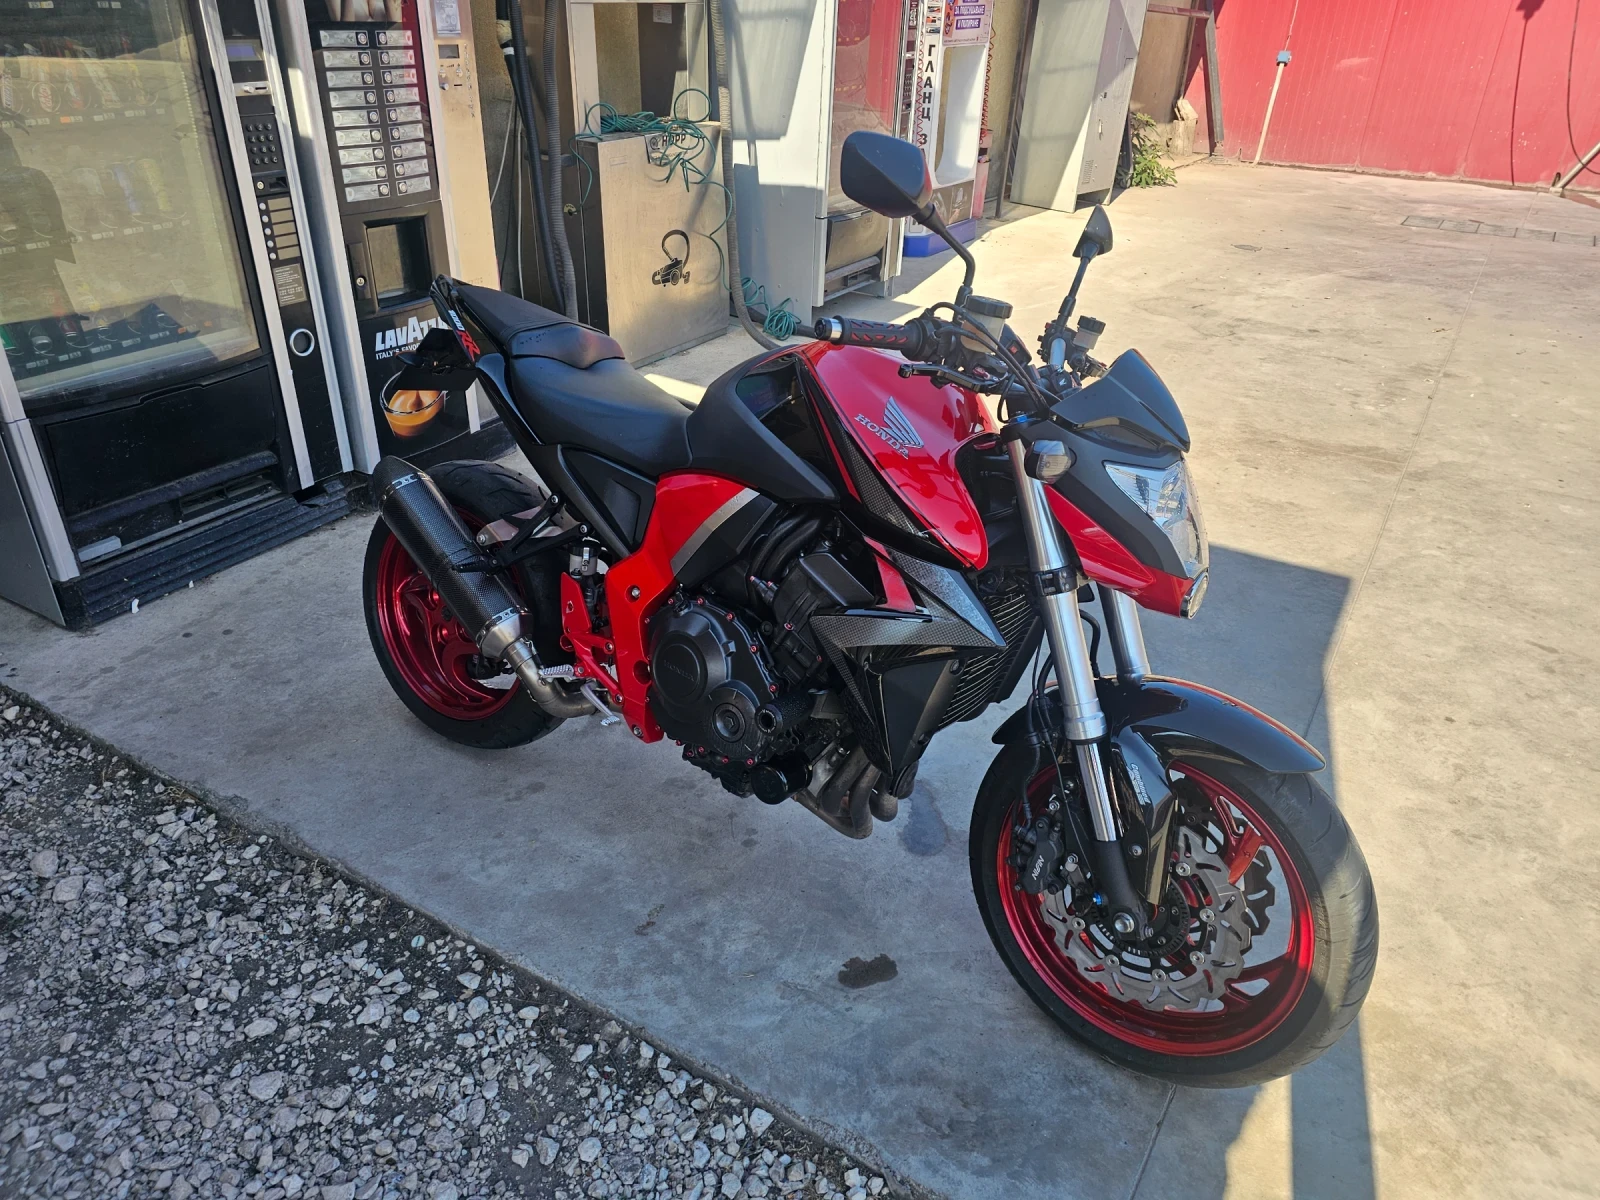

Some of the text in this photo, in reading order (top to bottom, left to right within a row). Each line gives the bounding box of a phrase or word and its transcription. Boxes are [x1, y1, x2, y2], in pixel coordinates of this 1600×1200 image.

[921, 44, 936, 121] ГЛАНЦ
[448, 309, 480, 362] 1000 RR
[853, 413, 909, 460] HONDA
[663, 659, 695, 682] HONDA
[1031, 854, 1045, 881] NISSIN
